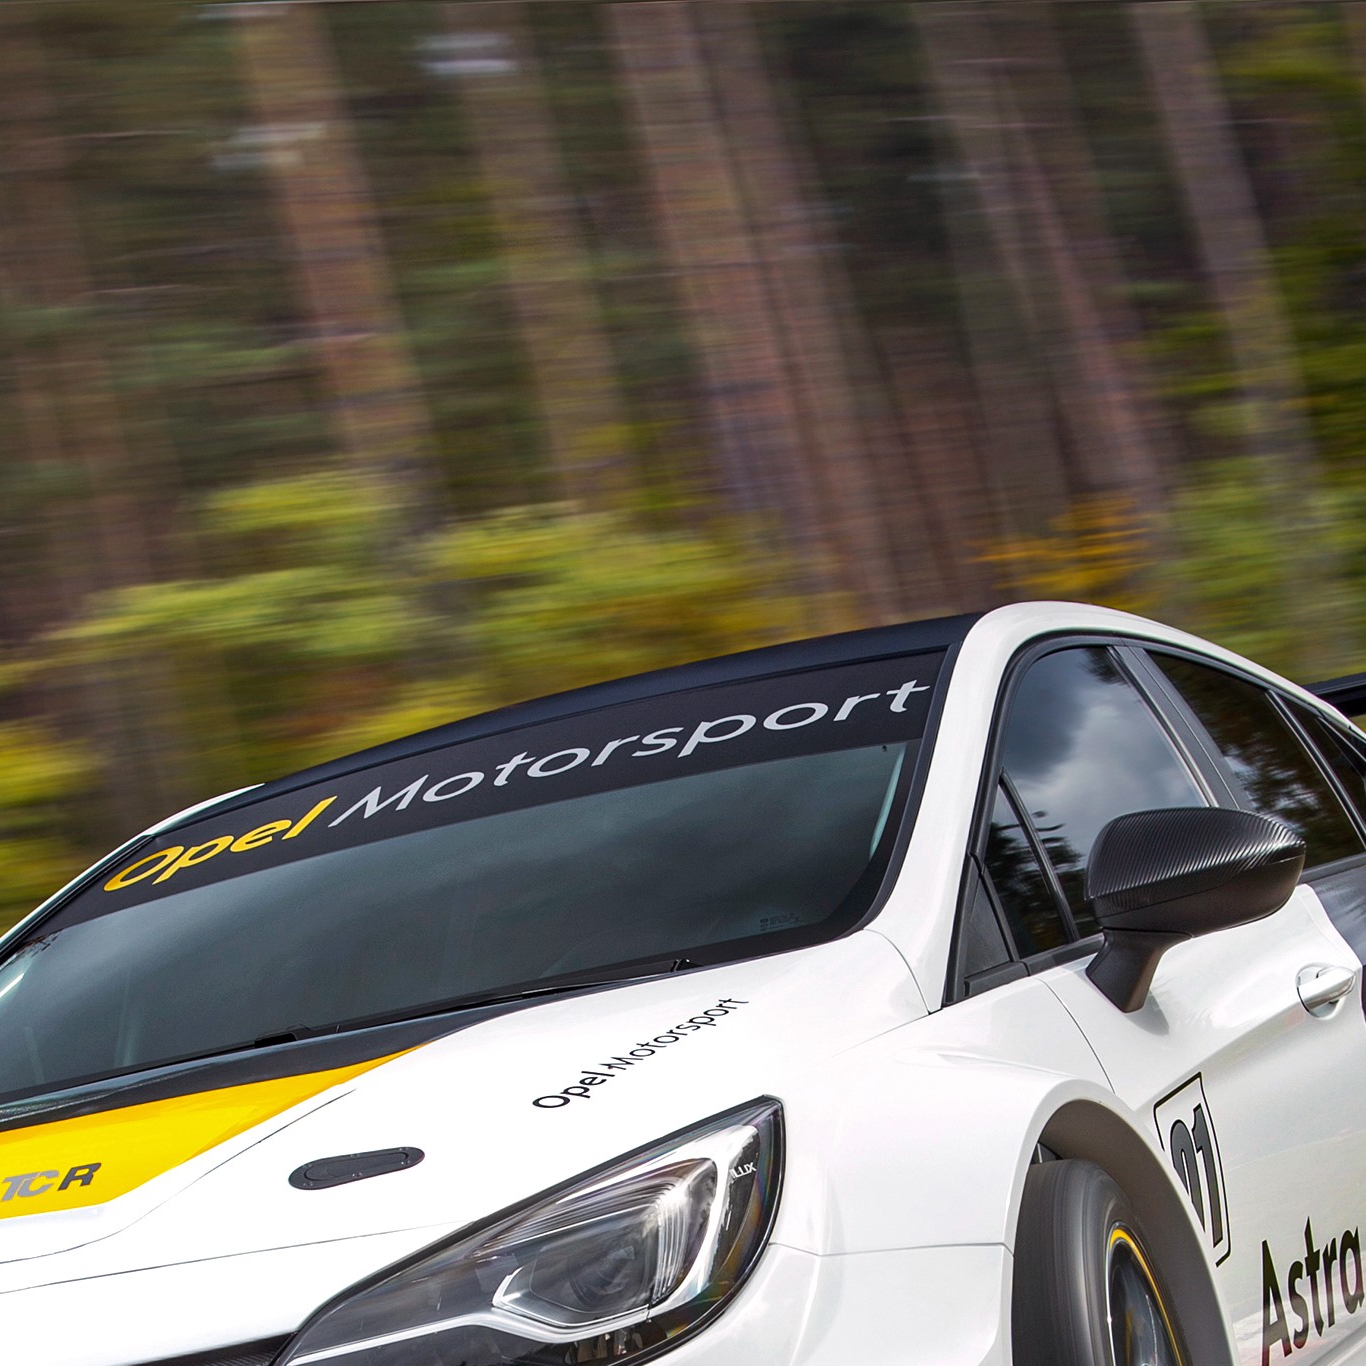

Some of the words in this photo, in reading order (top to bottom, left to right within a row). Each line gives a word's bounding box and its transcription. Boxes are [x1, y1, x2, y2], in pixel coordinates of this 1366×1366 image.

[103, 795, 338, 892] Opel
[327, 679, 931, 828] Motorsport
[531, 1070, 616, 1109] Opel
[598, 997, 750, 1071] Motorsport
